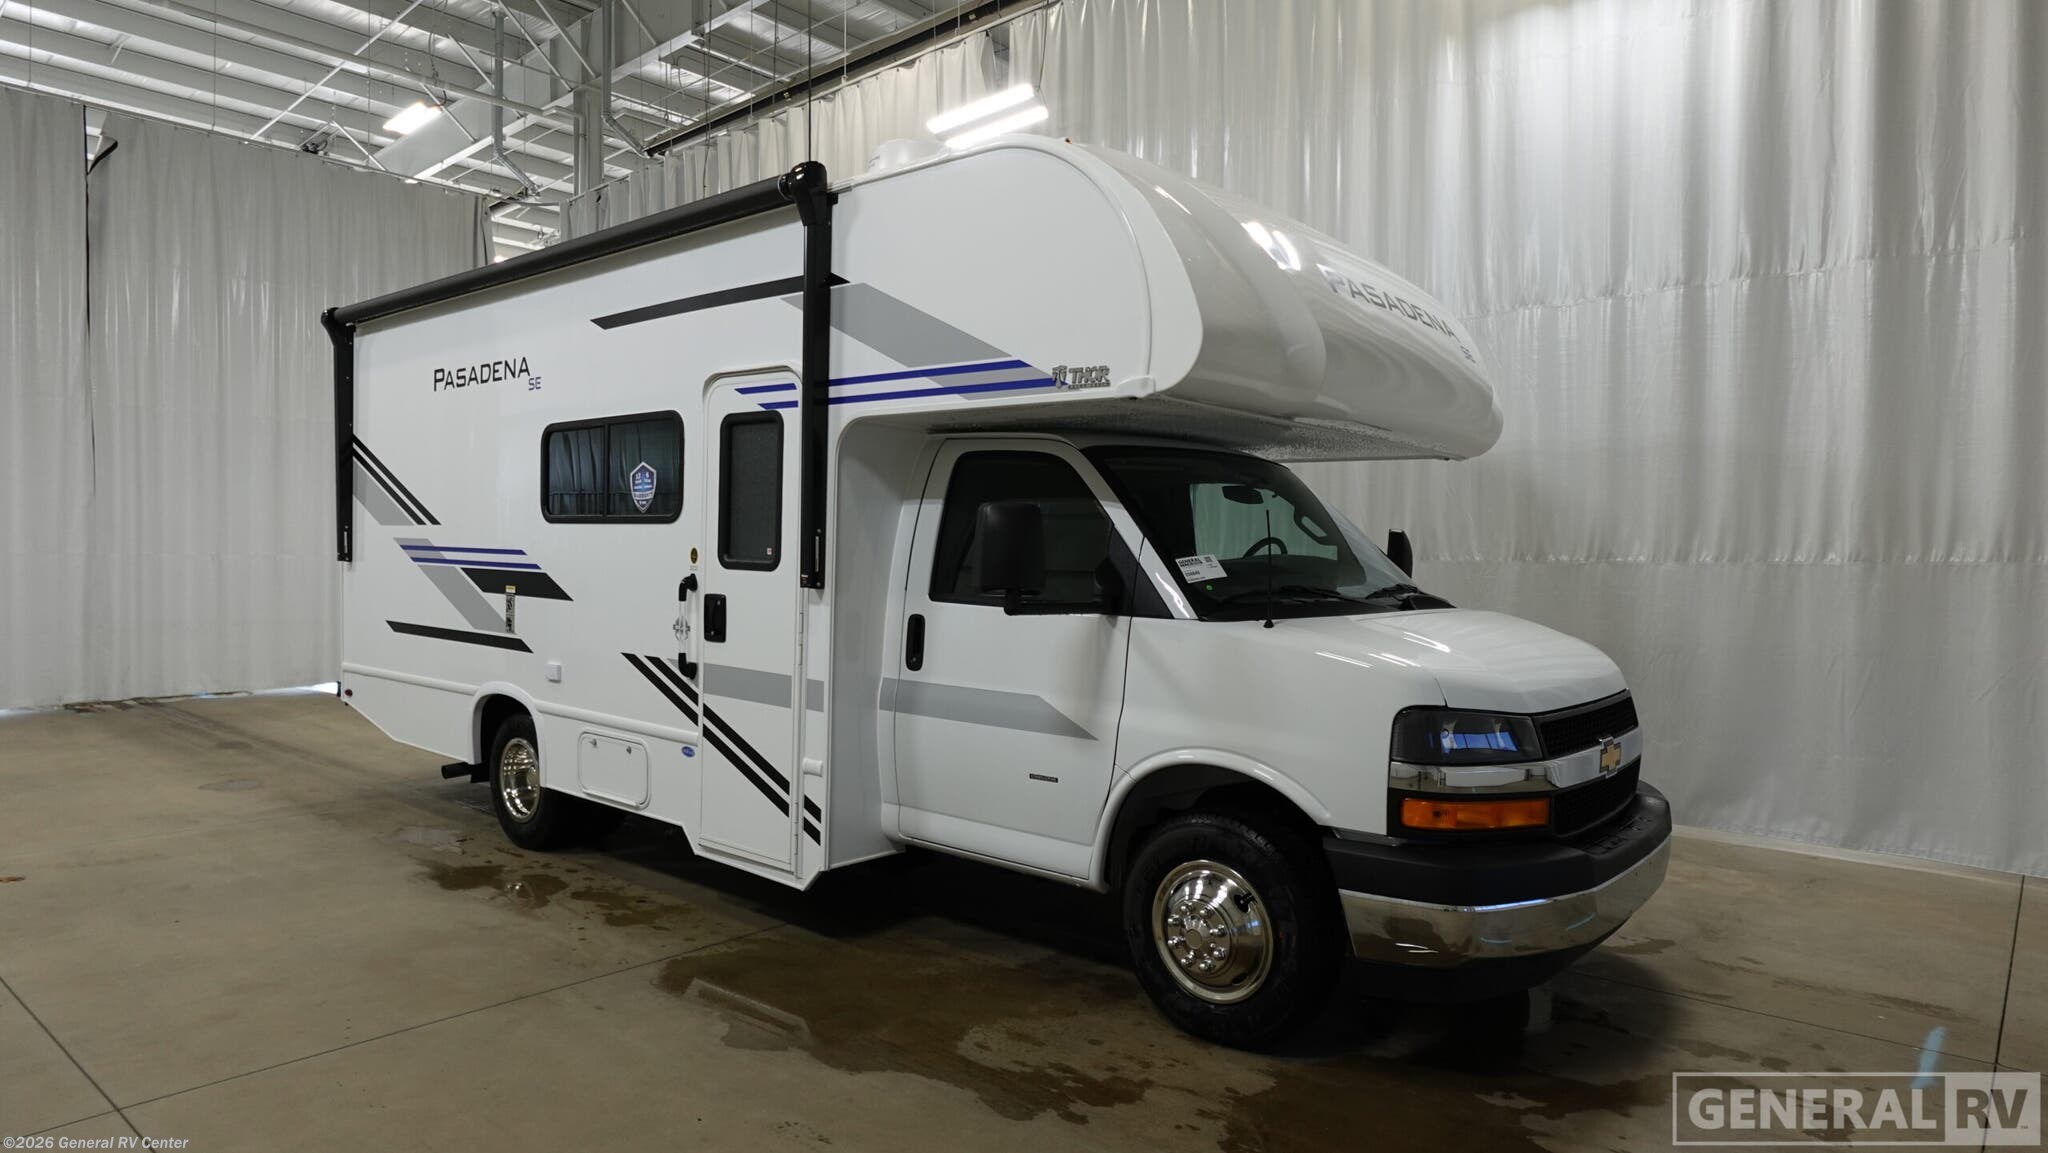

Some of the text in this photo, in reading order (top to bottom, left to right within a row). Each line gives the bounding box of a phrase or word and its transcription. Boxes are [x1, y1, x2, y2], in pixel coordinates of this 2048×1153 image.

[1324, 269, 1460, 343] PASADENA
[433, 356, 530, 391] PASADENA
[528, 376, 542, 391] SE
[1068, 365, 1110, 384] THOR
